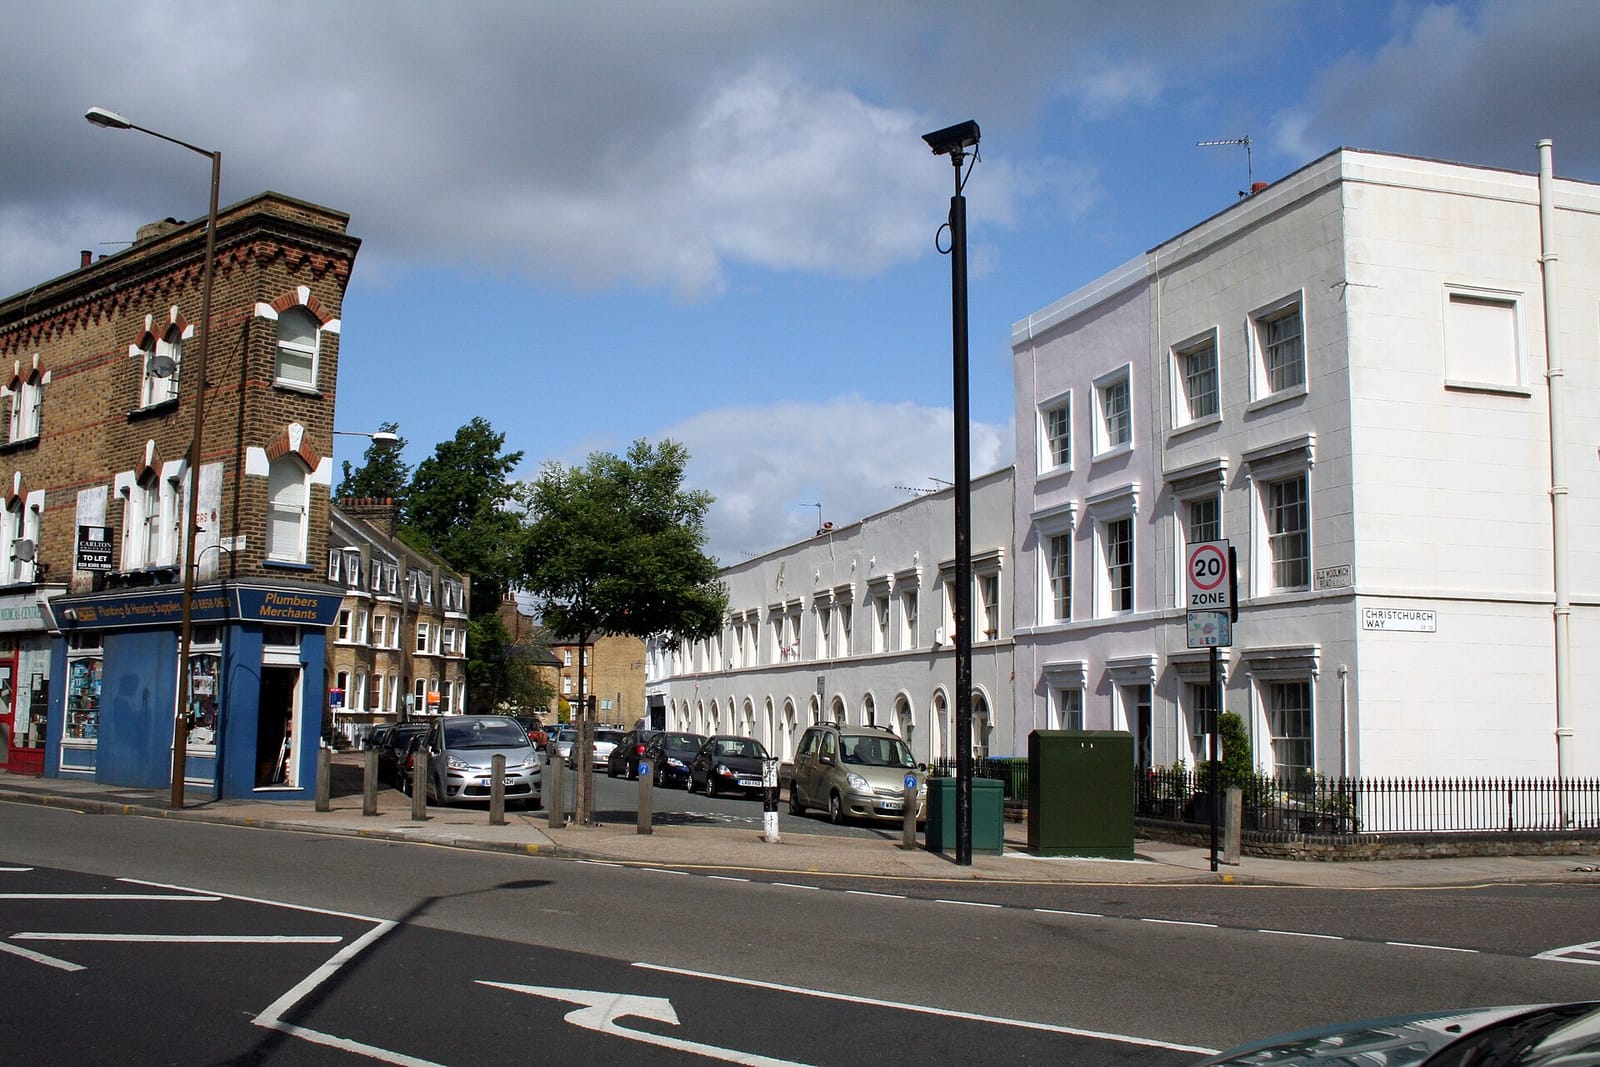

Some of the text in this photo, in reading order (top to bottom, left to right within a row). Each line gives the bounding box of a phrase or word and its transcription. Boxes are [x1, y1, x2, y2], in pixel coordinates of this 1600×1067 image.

[1195, 558, 1220, 577] 20
[264, 592, 318, 608] Plumbers
[1192, 592, 1225, 605] ZONE
[156, 601, 182, 616] Supplies
[259, 605, 317, 619] Merchants
[1366, 610, 1433, 620] CHRISTCHURCH
[1366, 620, 1385, 628] WAY
